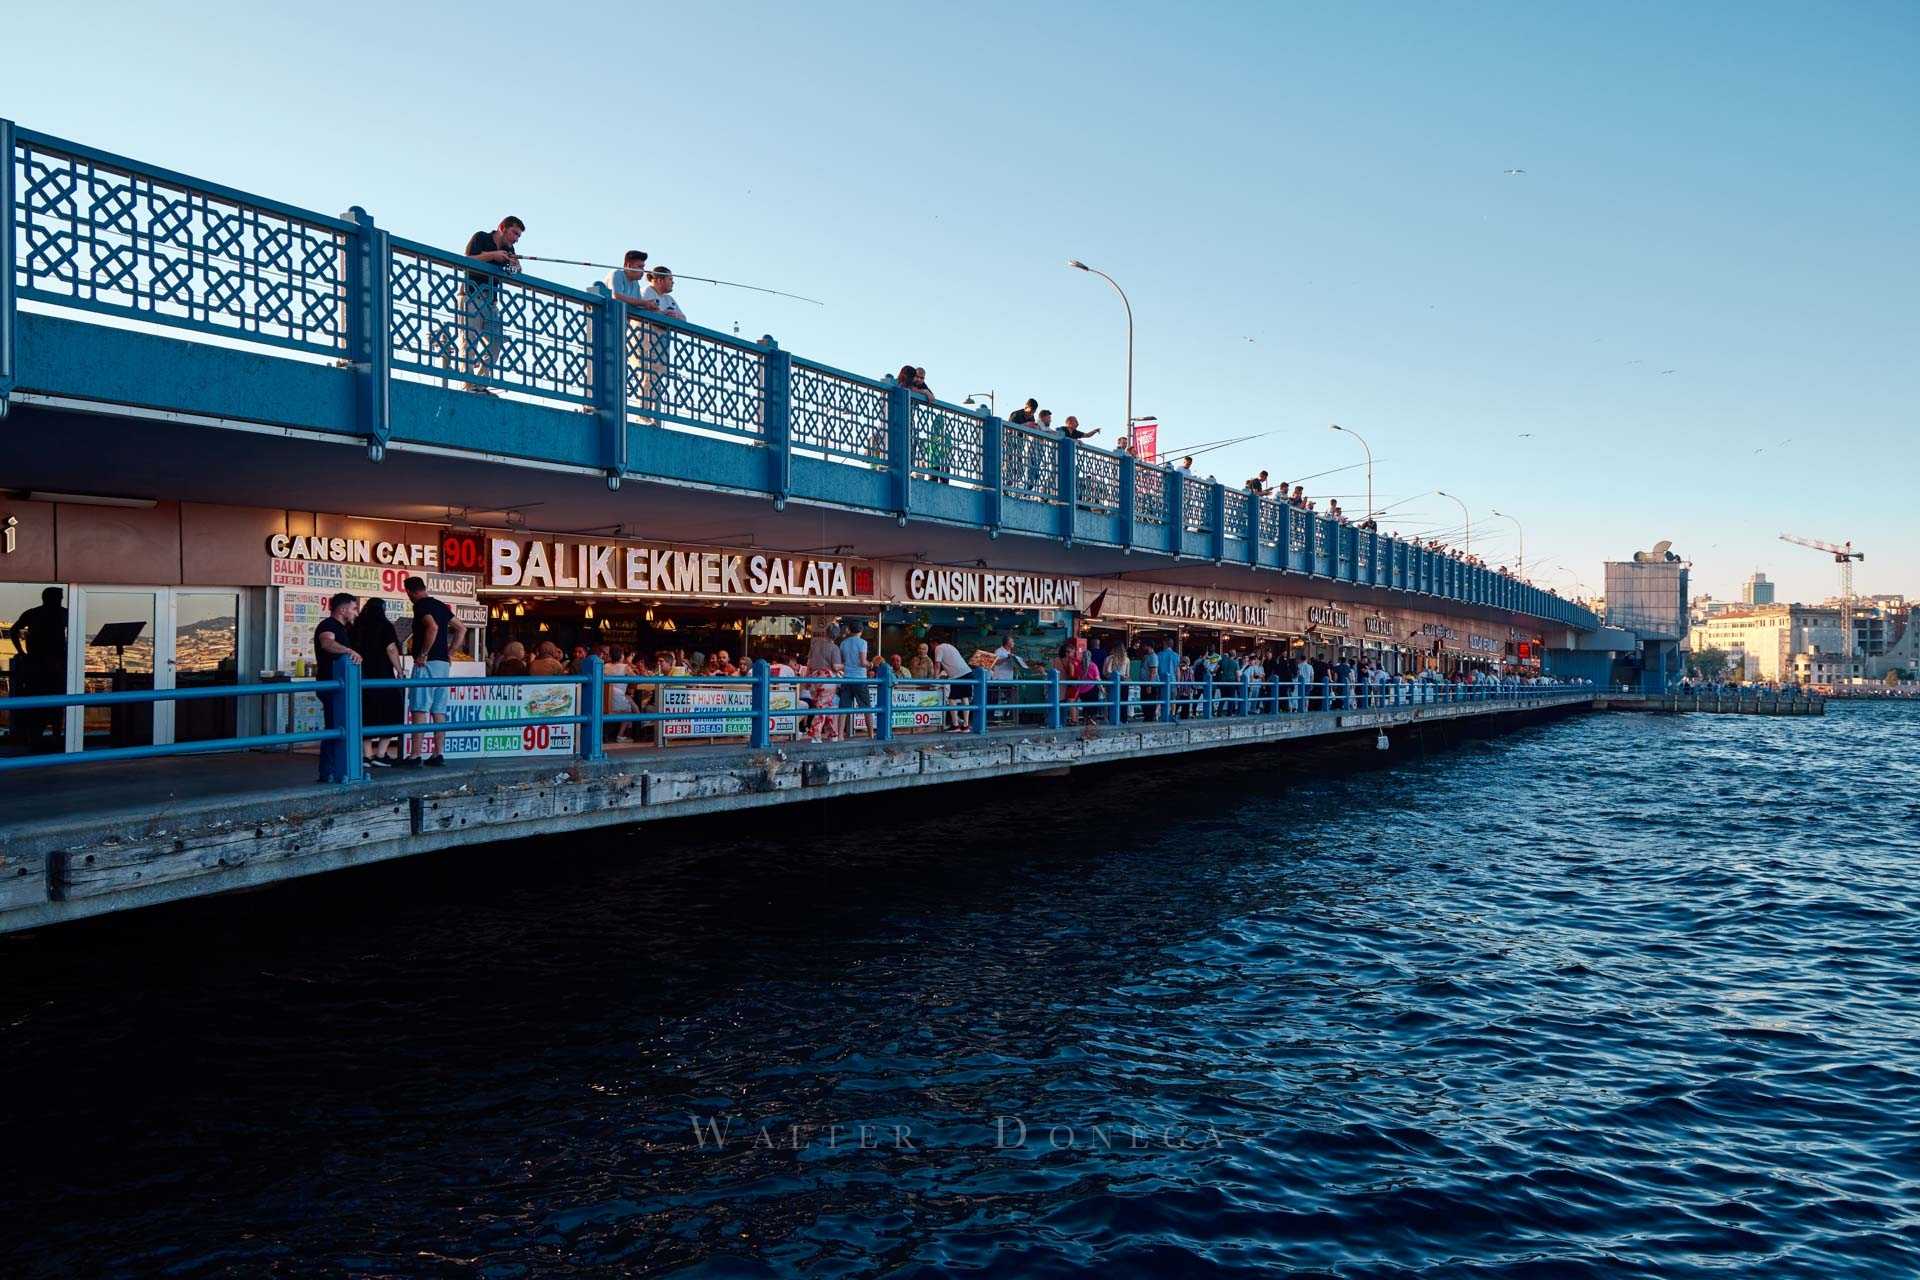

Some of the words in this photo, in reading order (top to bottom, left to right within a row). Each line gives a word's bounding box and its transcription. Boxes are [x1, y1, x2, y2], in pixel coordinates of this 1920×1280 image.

[271, 533, 370, 563] CANSIN
[376, 541, 438, 567] CAFE
[444, 537, 477, 567] 90
[273, 559, 305, 576] BALIK
[307, 562, 342, 579] EKMEK
[345, 567, 380, 582] SALATA
[427, 577, 473, 595] ALKOLSÜZ
[491, 537, 616, 588] BALIK
[626, 547, 745, 593] EKMEK
[749, 554, 849, 597] SALATA
[910, 569, 979, 601] CANSIN
[984, 574, 1081, 605] RESTAURANT
[1152, 592, 1197, 618] GALATA
[1202, 600, 1241, 624] SEMBOL
[1245, 606, 1269, 626] BALIK
[1310, 606, 1334, 626] GALATA
[666, 726, 690, 734] FISH
[694, 725, 722, 733] BREAD
[915, 713, 930, 724] 90
[444, 737, 480, 752] BREAD
[486, 736, 519, 751] SALAD
[523, 724, 550, 751] 90
[551, 726, 568, 735] TL
